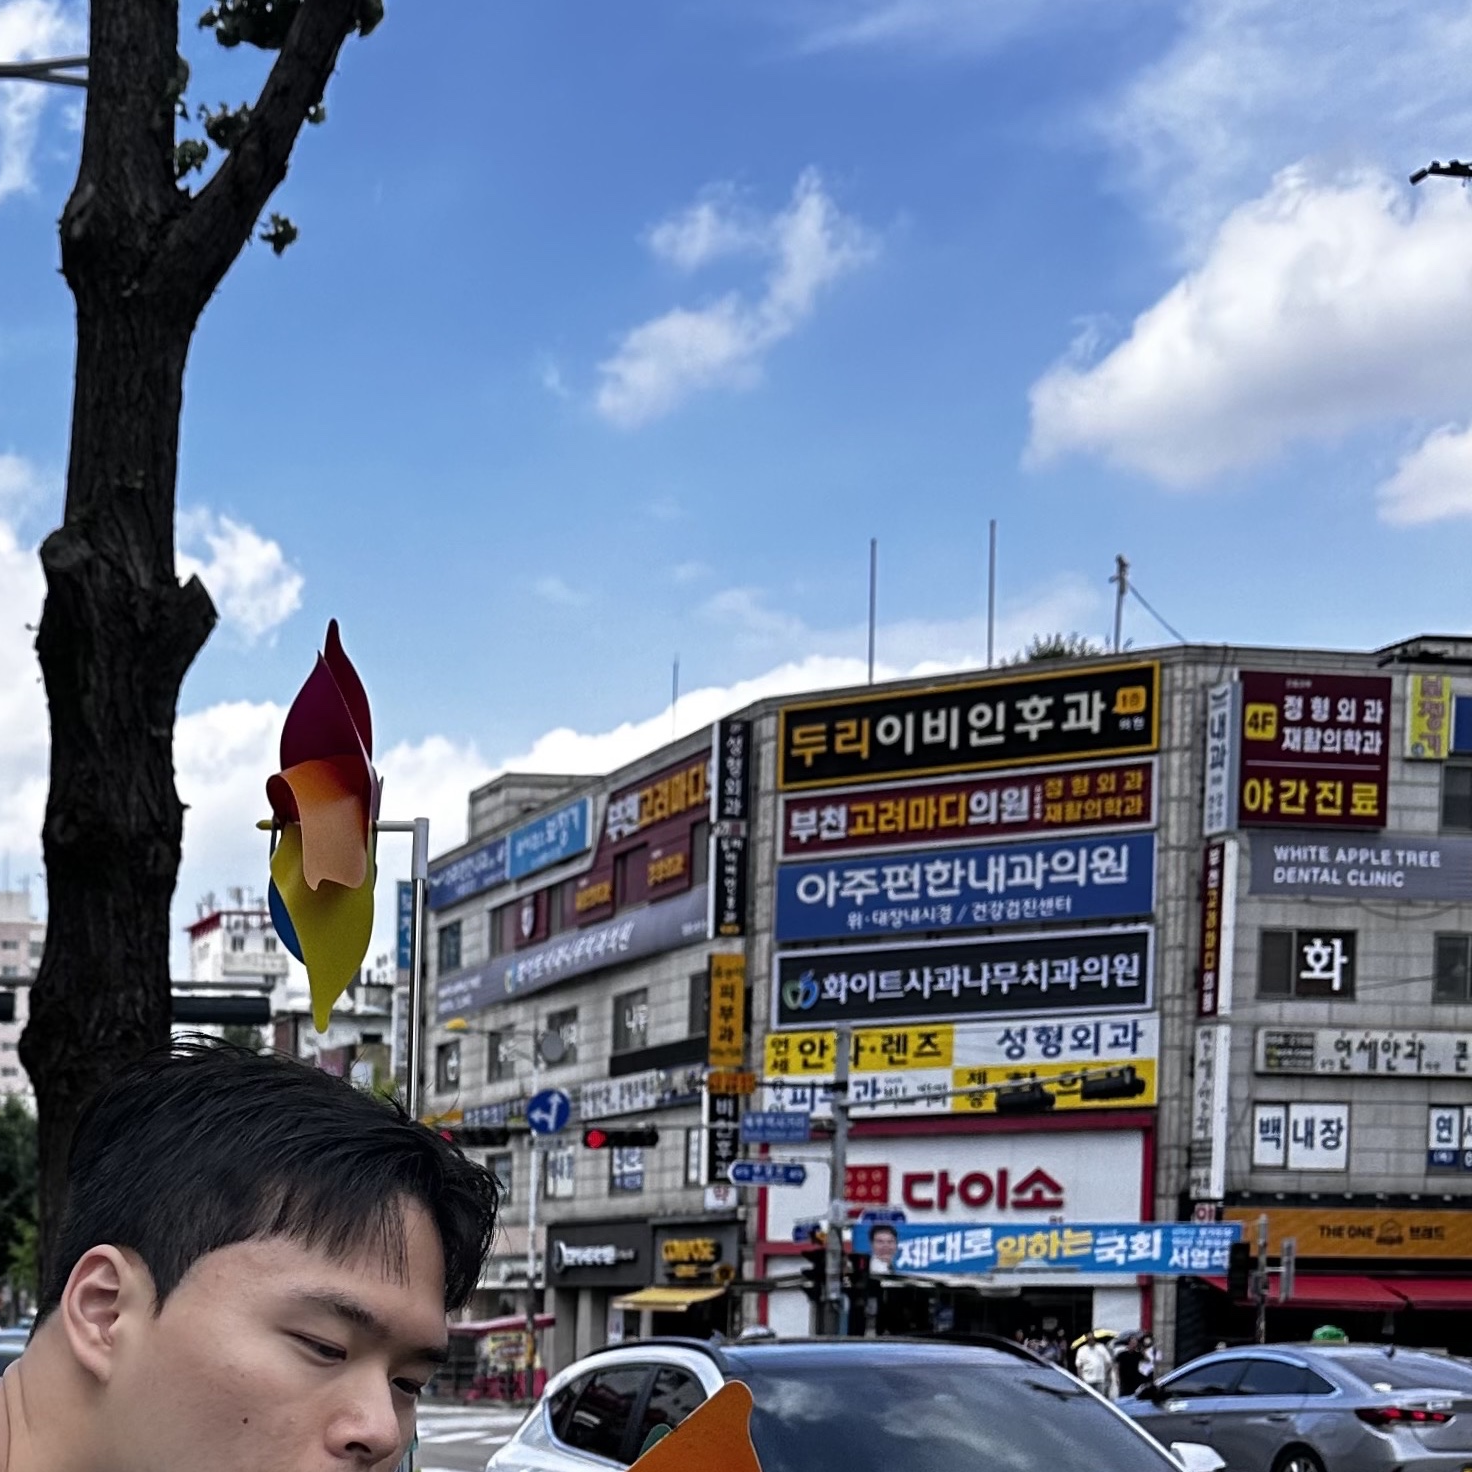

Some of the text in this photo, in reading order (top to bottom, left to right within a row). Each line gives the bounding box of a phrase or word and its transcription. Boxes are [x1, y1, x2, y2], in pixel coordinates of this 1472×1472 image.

[791, 690, 1106, 768] 두리이비인후과
[1247, 710, 1274, 734] 4F
[790, 786, 1030, 844] 부천고려마디의원
[1243, 777, 1380, 816] 야간진료
[796, 844, 1129, 908] 아주편한내과의원
[1273, 845, 1441, 868] WHITE APPLE TREE
[1273, 867, 1406, 888] DENTAL CLINIC
[821, 953, 1141, 1004] 화이트사과나무치과의원
[1299, 937, 1349, 991] 화
[997, 1018, 1145, 1059] 성형외과
[1258, 1116, 1345, 1151] 백내장
[901, 1166, 1067, 1211] 다이소
[896, 1228, 994, 1268] 제대로
[995, 1227, 1093, 1269] 일하는
[1094, 1229, 1162, 1266] 국회
